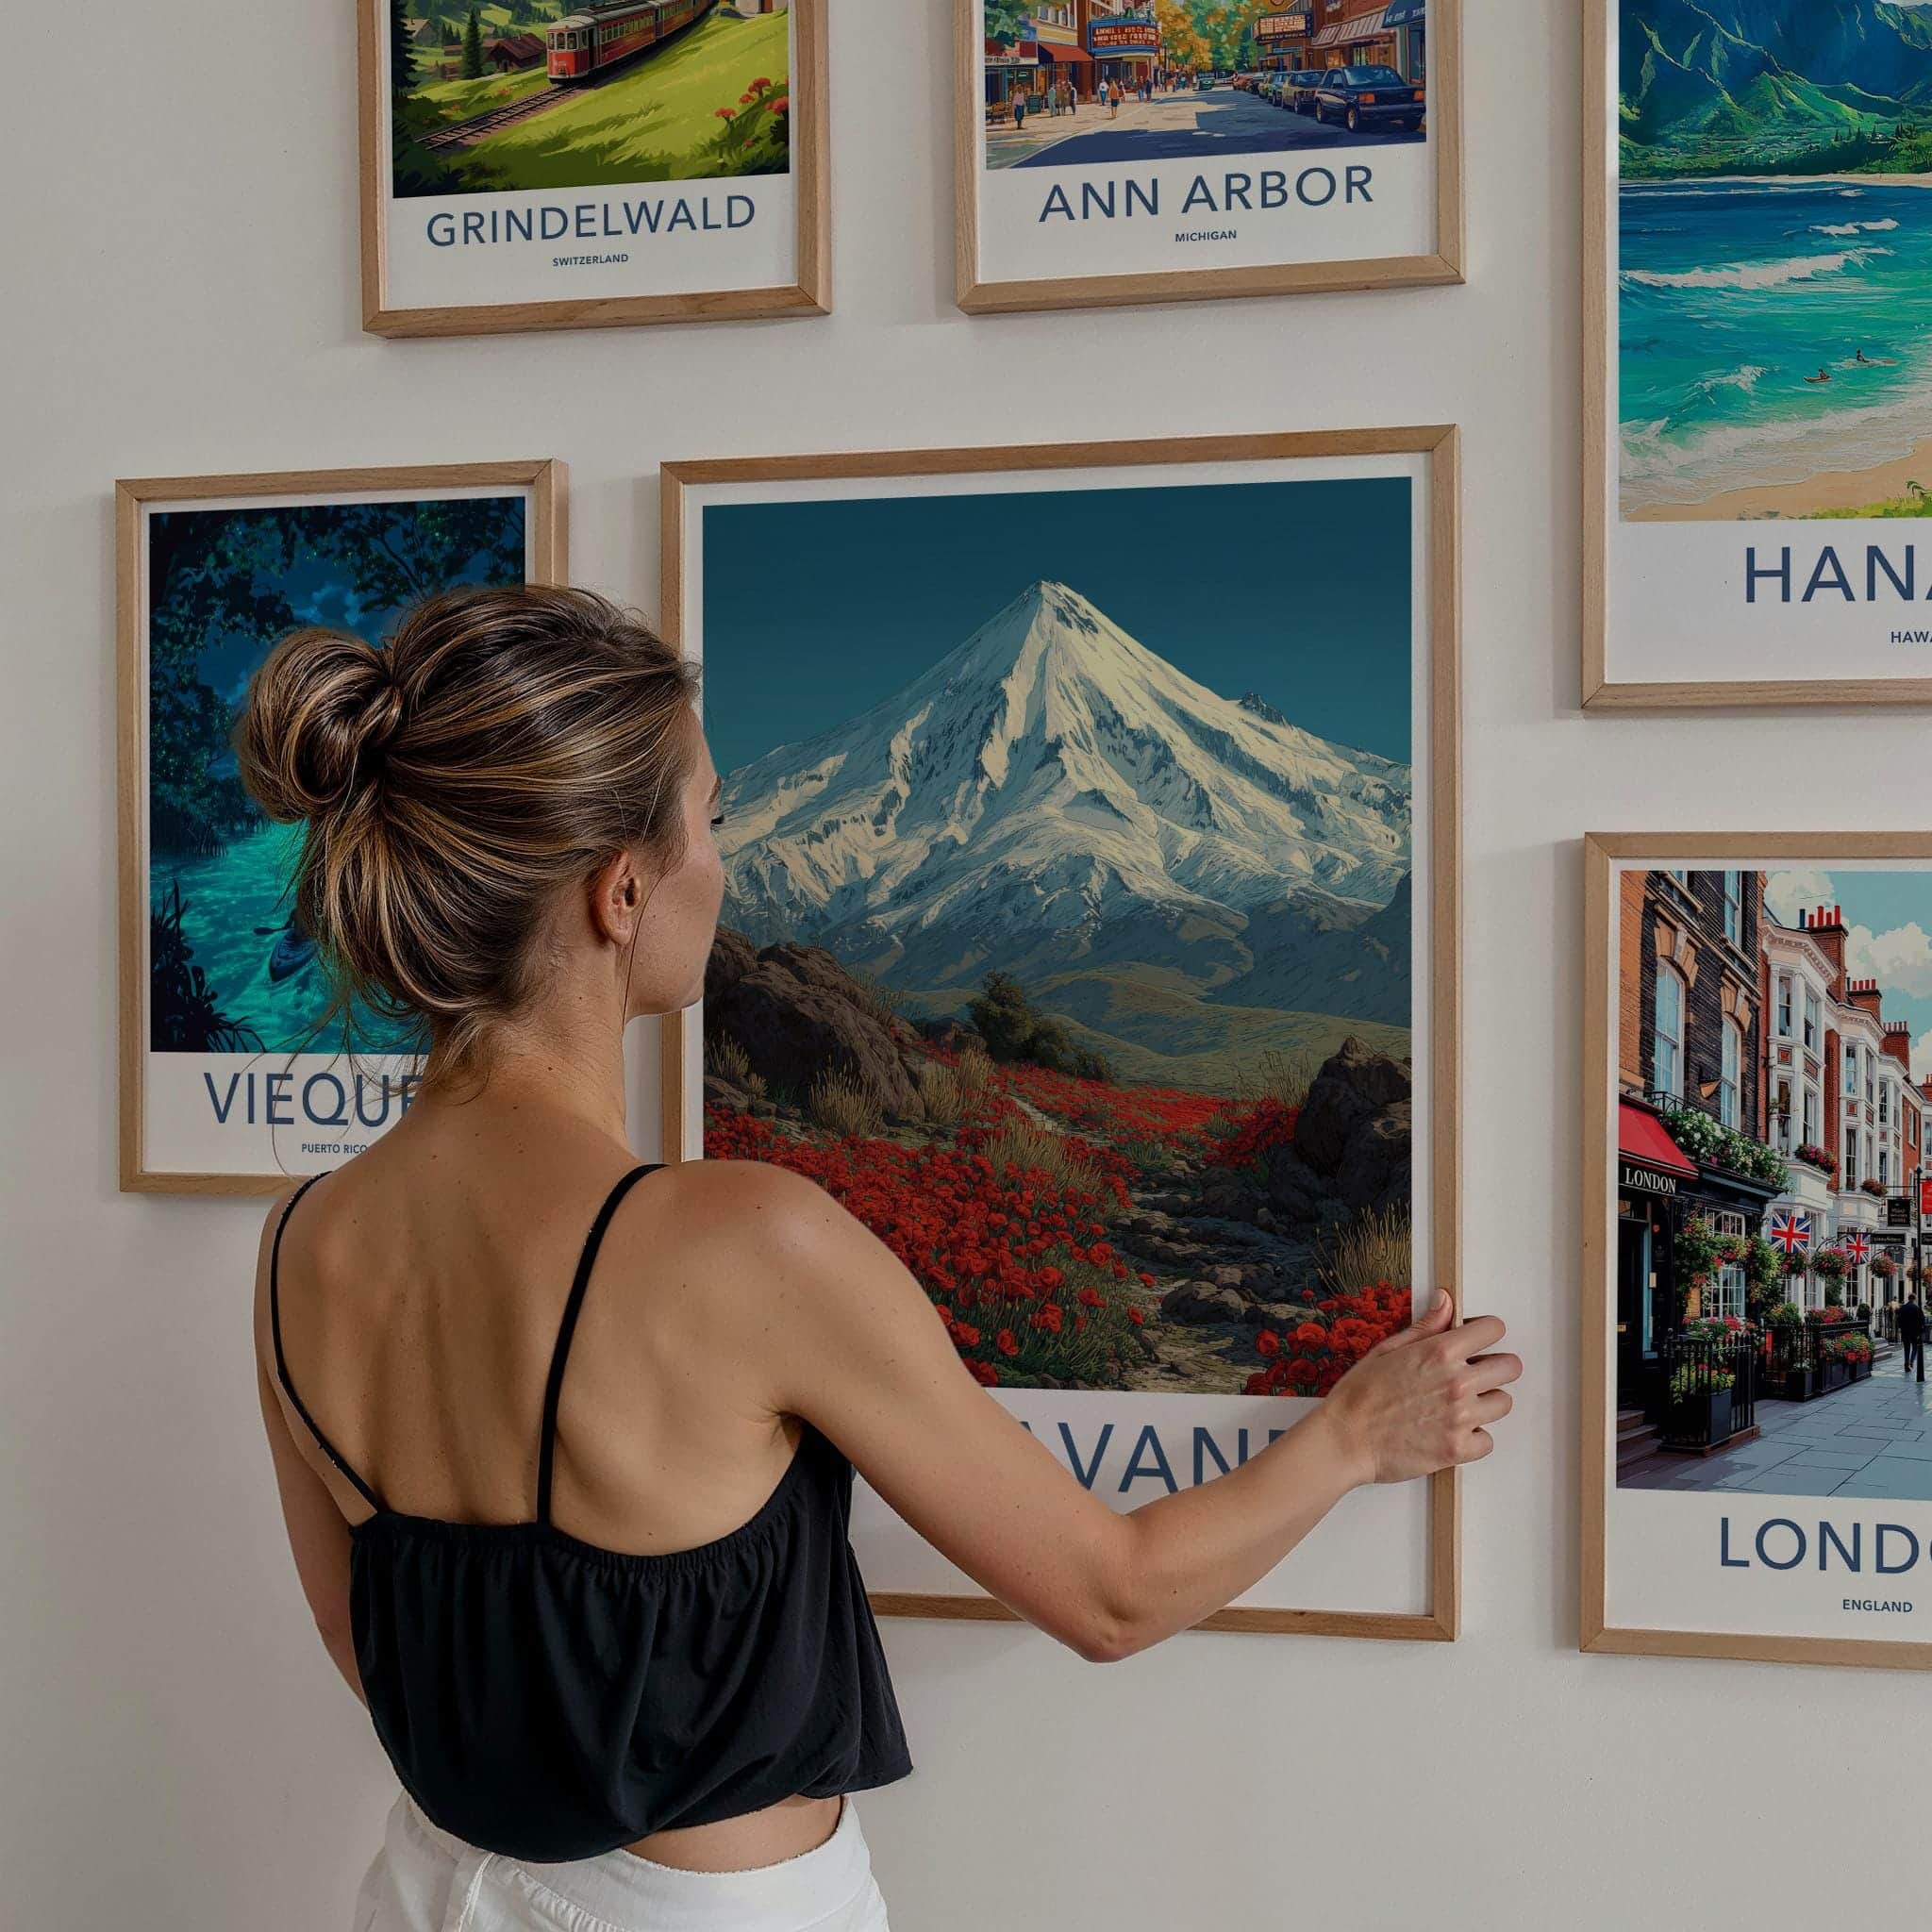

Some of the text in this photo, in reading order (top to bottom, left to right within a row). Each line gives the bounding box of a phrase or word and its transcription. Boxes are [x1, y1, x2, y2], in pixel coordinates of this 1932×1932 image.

[1039, 165, 1374, 223] ANN ARBOR
[426, 194, 756, 247] GRINDELWALD
[1174, 229, 1237, 242] MICHIGAN
[552, 253, 629, 267] SWITZERLAND
[1745, 544, 1932, 603] HAN
[1890, 631, 1932, 644] HAW
[301, 1143, 368, 1155] PUERTO RICO
[1625, 1167, 1676, 1194] LONDON
[1721, 1517, 1932, 1574] LOND
[1842, 1599, 1913, 1613] ENGLAND
